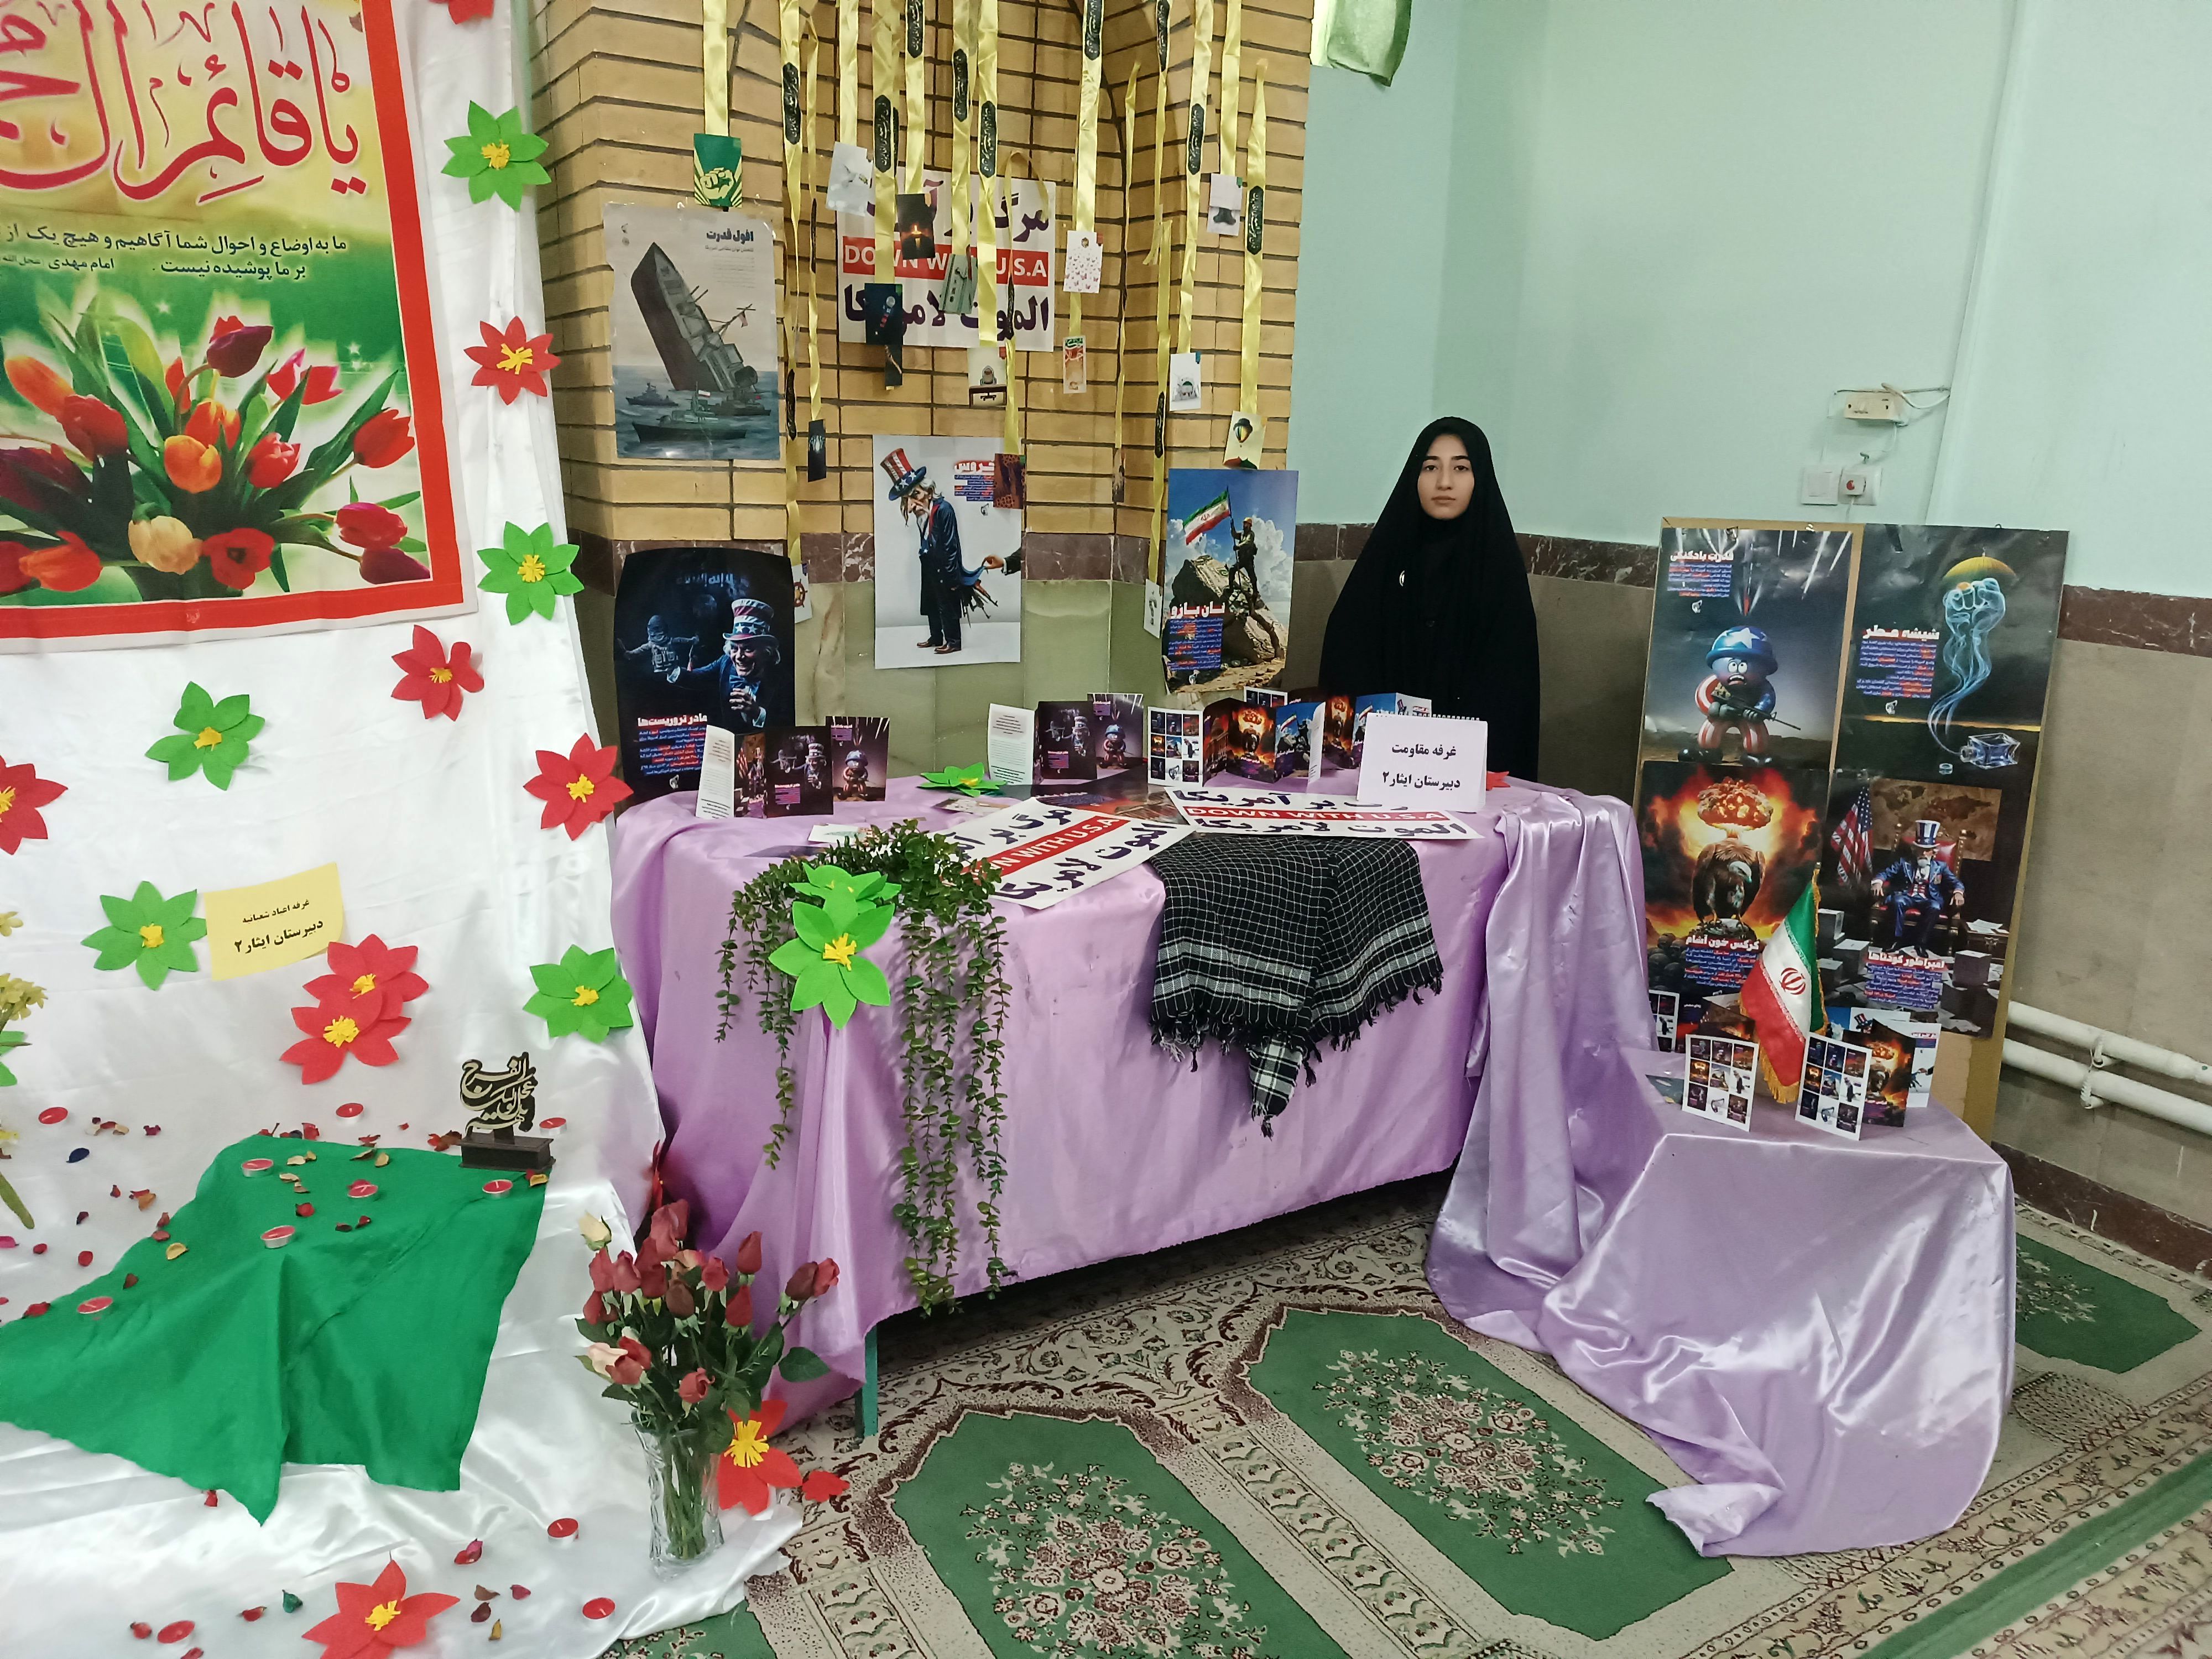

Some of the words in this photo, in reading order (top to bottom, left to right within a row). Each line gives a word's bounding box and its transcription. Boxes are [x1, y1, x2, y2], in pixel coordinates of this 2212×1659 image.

[6, 222, 19, 242] از
[27, 226, 59, 245] یک
[63, 232, 99, 247] هیچ
[706, 228, 732, 242] قدرت
[733, 229, 754, 244] افول
[105, 236, 112, 249] و
[116, 230, 170, 251] آگاهیم
[176, 234, 207, 249] شما
[211, 236, 255, 255] احوال
[270, 237, 313, 257] اوضاع
[316, 239, 328, 254] به
[333, 236, 347, 249] ما
[259, 243, 267, 255] و
[91, 257, 114, 272] امام
[845, 245, 918, 269] DON
[49, 258, 87, 272] مهدی
[161, 260, 210, 277] نیست
[213, 260, 272, 280] پوشیده
[275, 262, 289, 276] ما
[294, 264, 305, 280] بر
[1901, 628, 1939, 641] شیشه
[688, 713, 708, 725] مادر
[1392, 744, 1429, 757] مقاومت
[1433, 745, 1456, 759] غرفه
[1414, 775, 1460, 791] دبیرستان
[1173, 790, 1292, 807] آمریکا
[1009, 810, 1072, 830] مرگ
[1186, 807, 1280, 818] DOWN
[1286, 811, 1364, 819] WITH
[1194, 818, 1331, 832] لامریکا
[1348, 823, 1467, 836] الموت
[1010, 836, 1074, 858] WITH
[1065, 818, 1120, 838] U.S.A
[1095, 823, 1177, 859] الموت
[274, 921, 324, 945] دبیرستان
[1686, 935, 1708, 945] آشام
[1709, 938, 1729, 948] خون
[1730, 940, 1760, 951] کرکس
